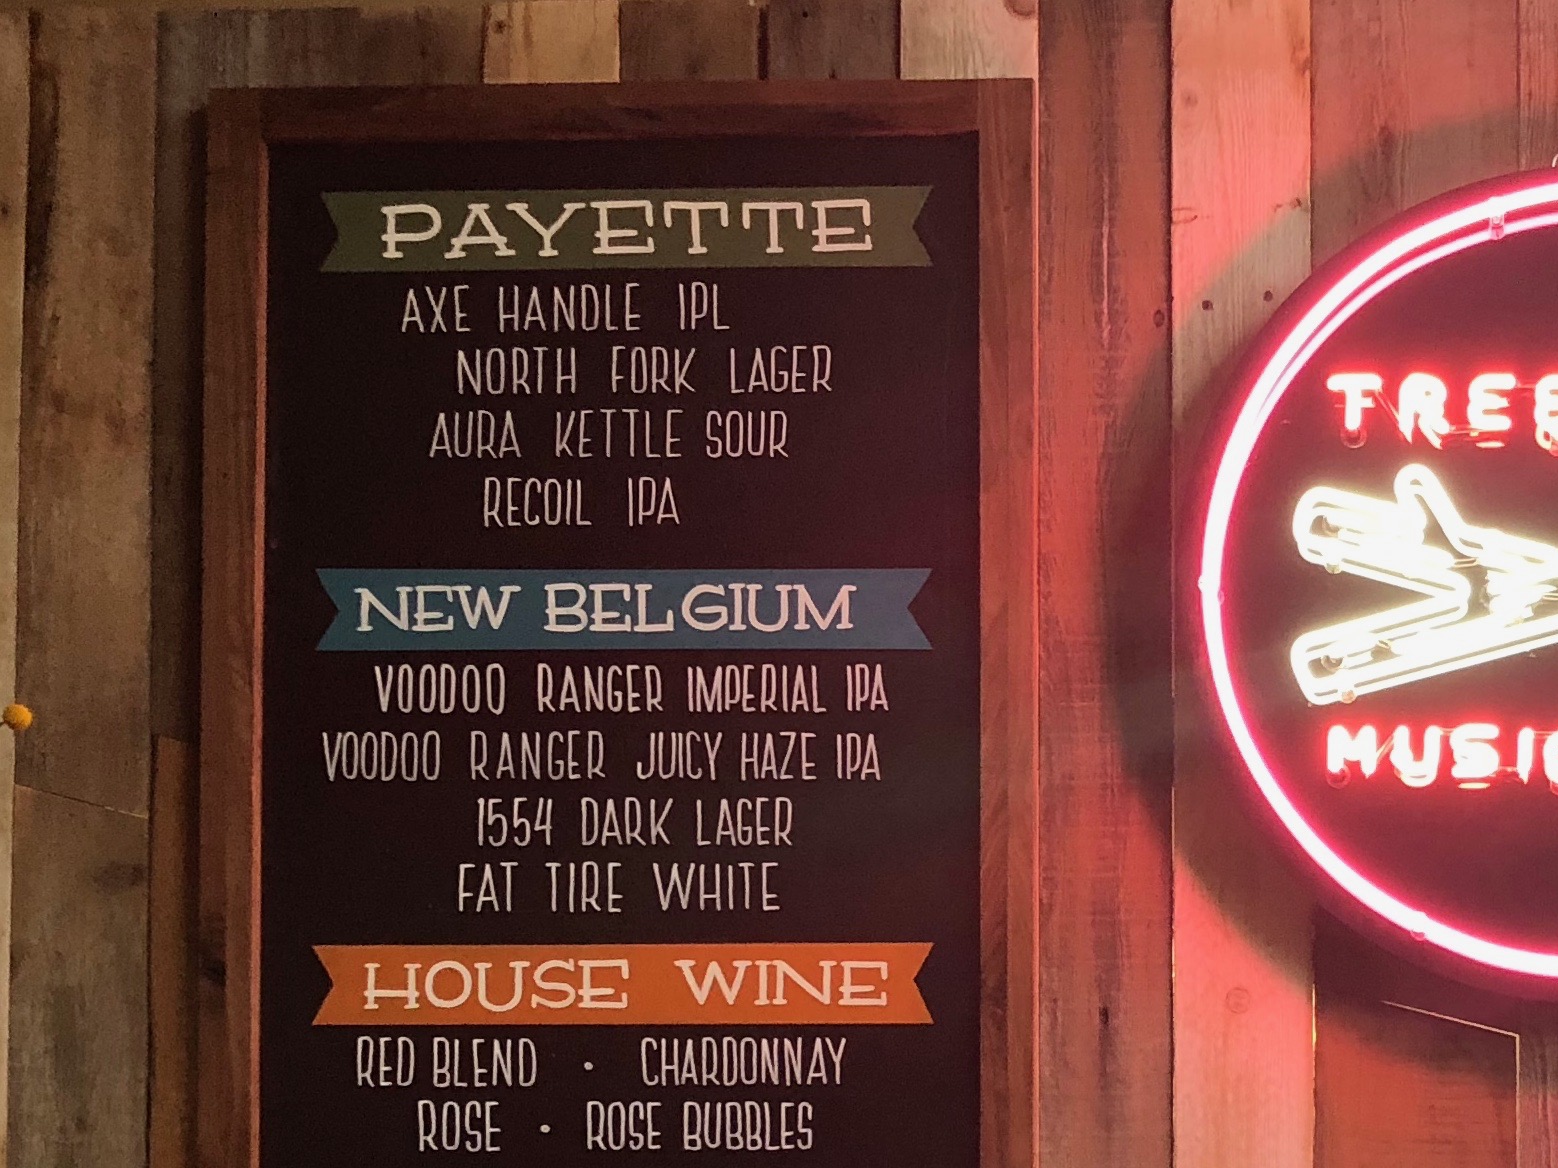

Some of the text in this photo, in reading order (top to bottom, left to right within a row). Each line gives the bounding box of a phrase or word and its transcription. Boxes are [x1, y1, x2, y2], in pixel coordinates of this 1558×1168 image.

[382, 199, 872, 258] PAYETTE
[402, 282, 729, 332] AXE HANDLE IPL
[458, 345, 831, 394] NORTH FORK LAGER
[430, 409, 787, 458] AURA KETTLE SOUR
[484, 477, 679, 526] RECOIL IPA
[355, 583, 856, 632] NEW BELGIUM
[375, 663, 888, 714] VOODOO RANGER IMPERIAL IPA
[323, 730, 880, 781] VOODOO RANGER JUICY HAZE IPA
[478, 797, 792, 846] 1554 DARK LAGER
[459, 861, 779, 912] FAT TIRE WHITE
[364, 959, 887, 1011] HOUSE WINE
[357, 1036, 846, 1087] RED BLEND CHARDONNAY
[418, 1100, 812, 1151] ROSE ROSE BUBBLES
